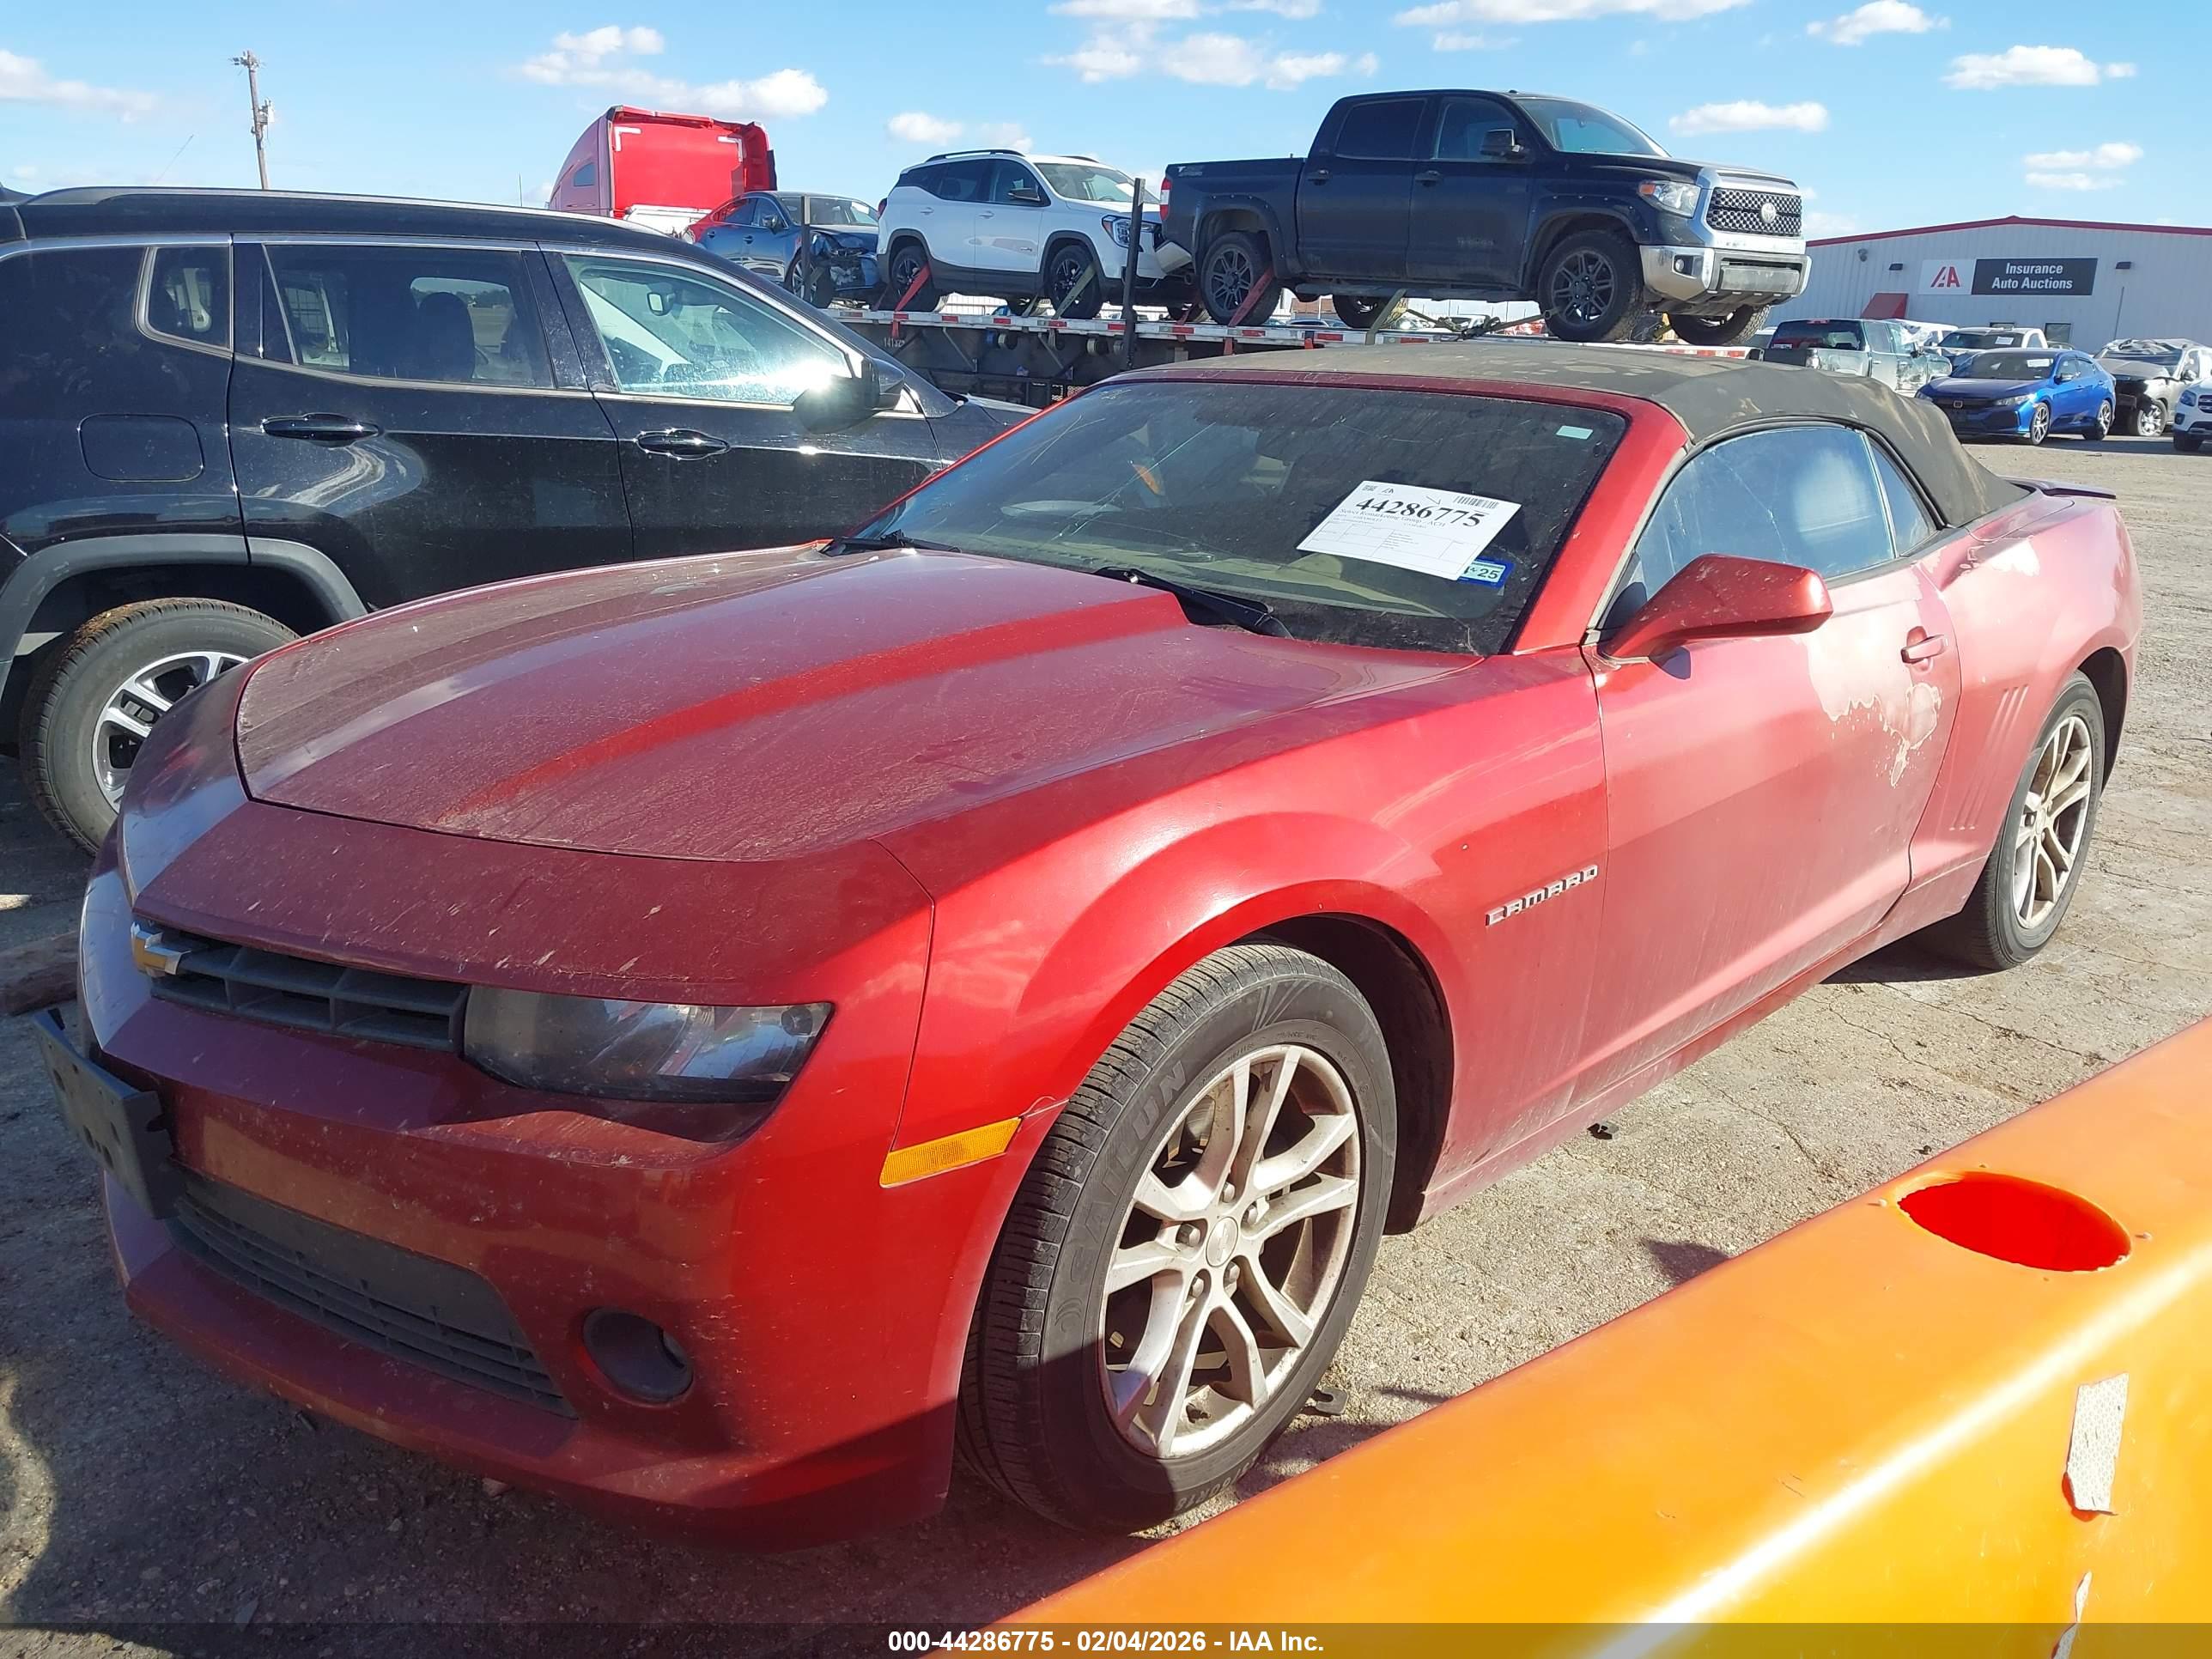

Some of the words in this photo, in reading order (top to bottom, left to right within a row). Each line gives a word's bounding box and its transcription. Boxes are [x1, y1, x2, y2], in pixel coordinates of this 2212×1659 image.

[2005, 263, 2063, 275] Insurance
[1991, 277, 2019, 289] Auto
[2021, 277, 2074, 289] Auctions
[1355, 497, 1485, 527] 44286775
[1476, 568, 1499, 580] 25
[1485, 865, 1598, 927] CAMARO
